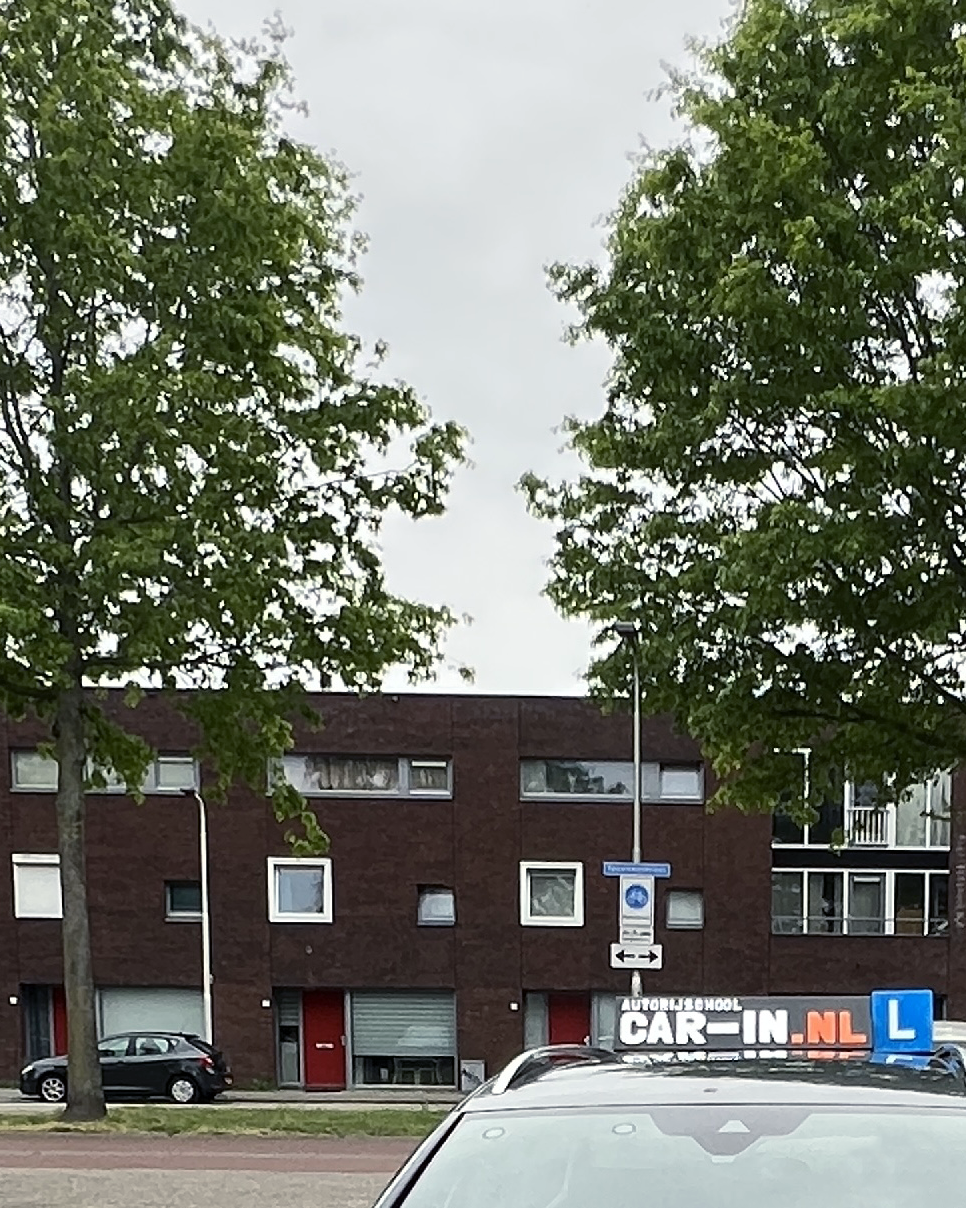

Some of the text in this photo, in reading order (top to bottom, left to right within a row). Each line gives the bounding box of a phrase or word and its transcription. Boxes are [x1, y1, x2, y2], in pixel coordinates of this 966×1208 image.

[620, 998, 743, 1011] AUTORIJSCHOOL
[888, 999, 915, 1039] L
[619, 1010, 867, 1045] CAR-IN.NL
